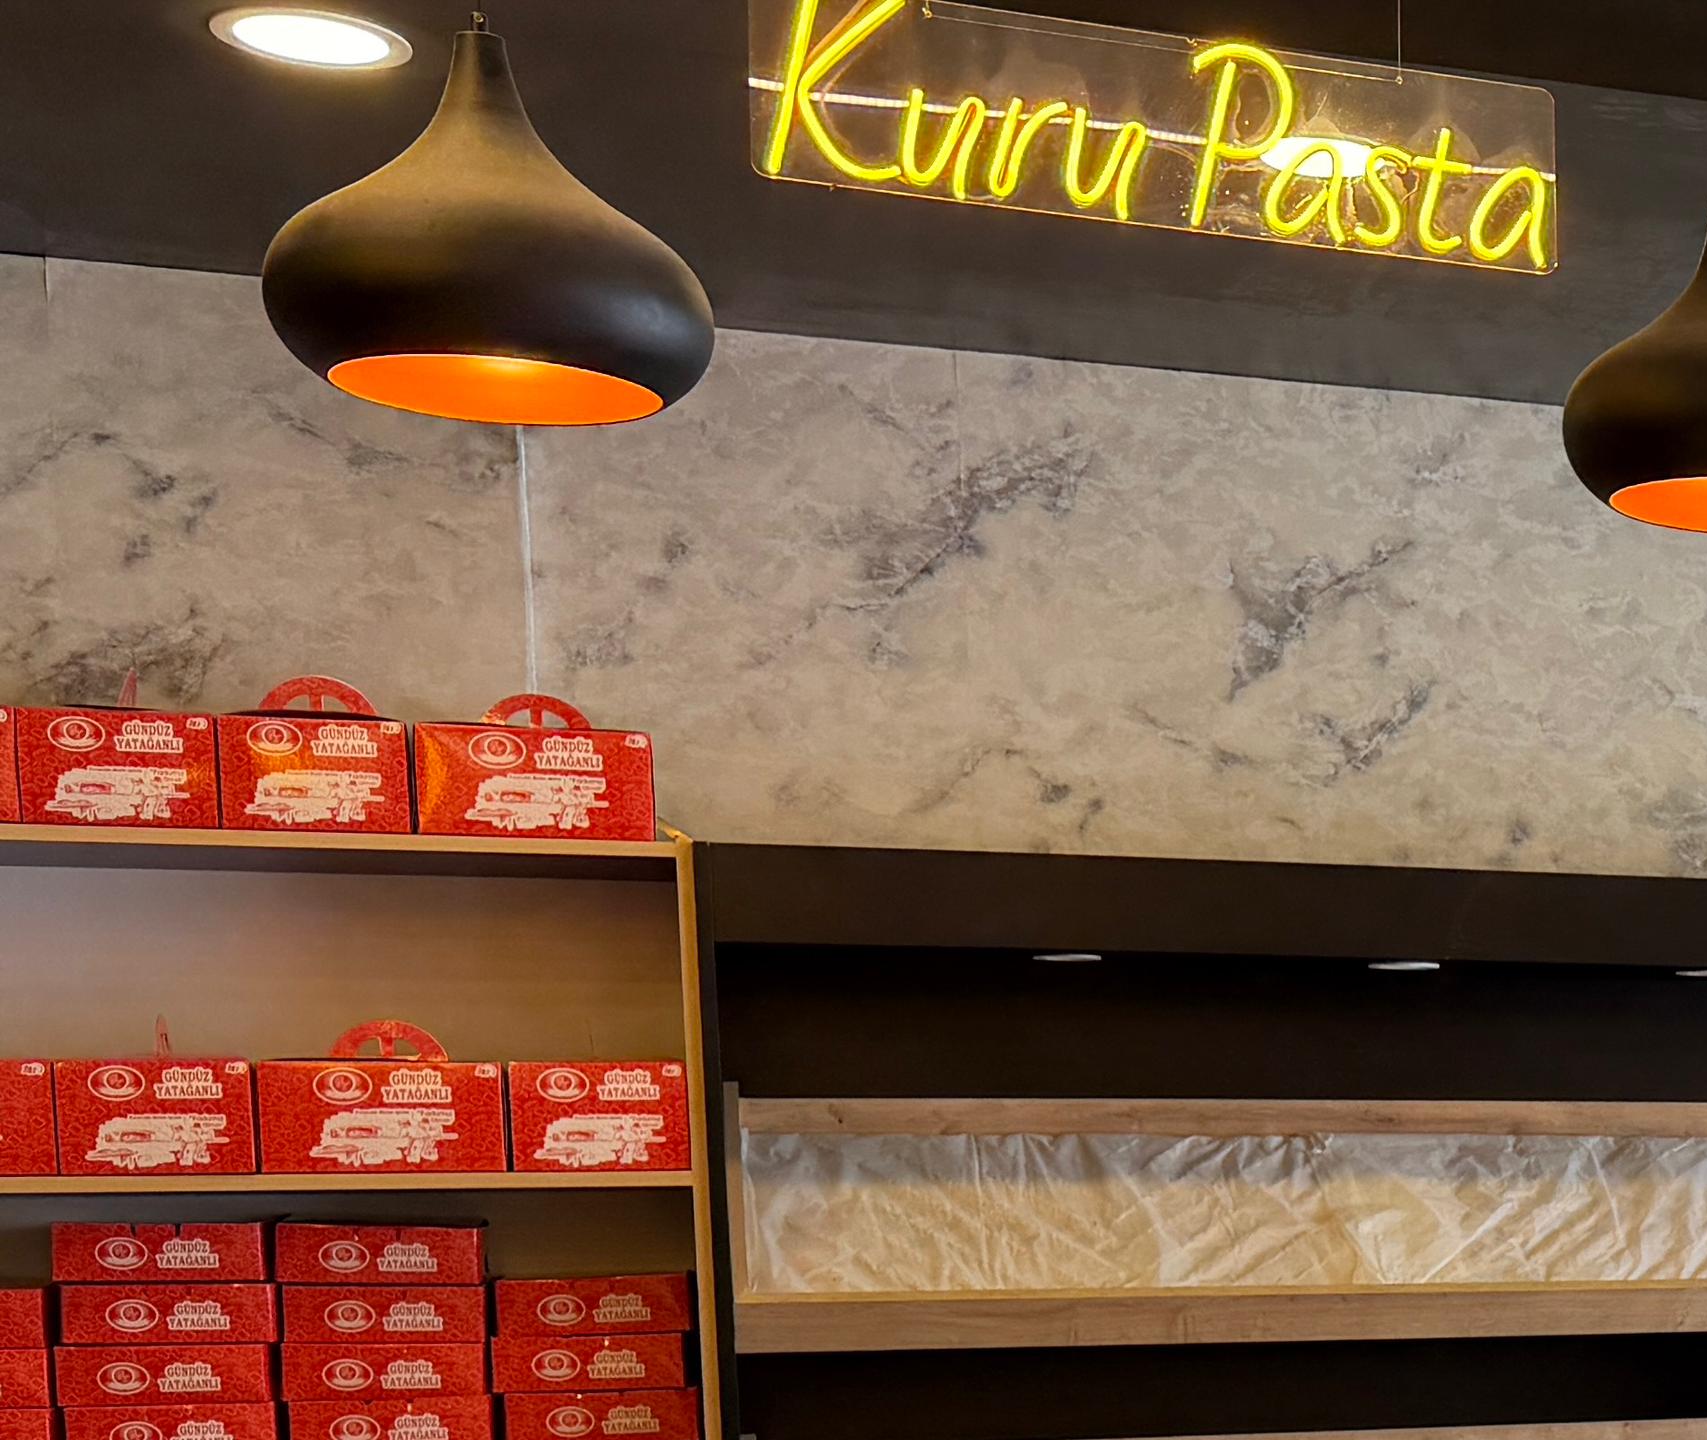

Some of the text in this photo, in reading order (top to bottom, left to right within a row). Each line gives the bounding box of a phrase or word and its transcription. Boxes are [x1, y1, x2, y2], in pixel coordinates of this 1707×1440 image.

[763, 0, 1550, 271] Kuru Pasta
[124, 722, 172, 737] GÜNDÜZ
[320, 727, 366, 741] GÜNDÜZ
[544, 737, 592, 753] GÜNDÜZ
[164, 1068, 211, 1083] GÜNDÜZ
[391, 1070, 441, 1085] GÜNDÜZ
